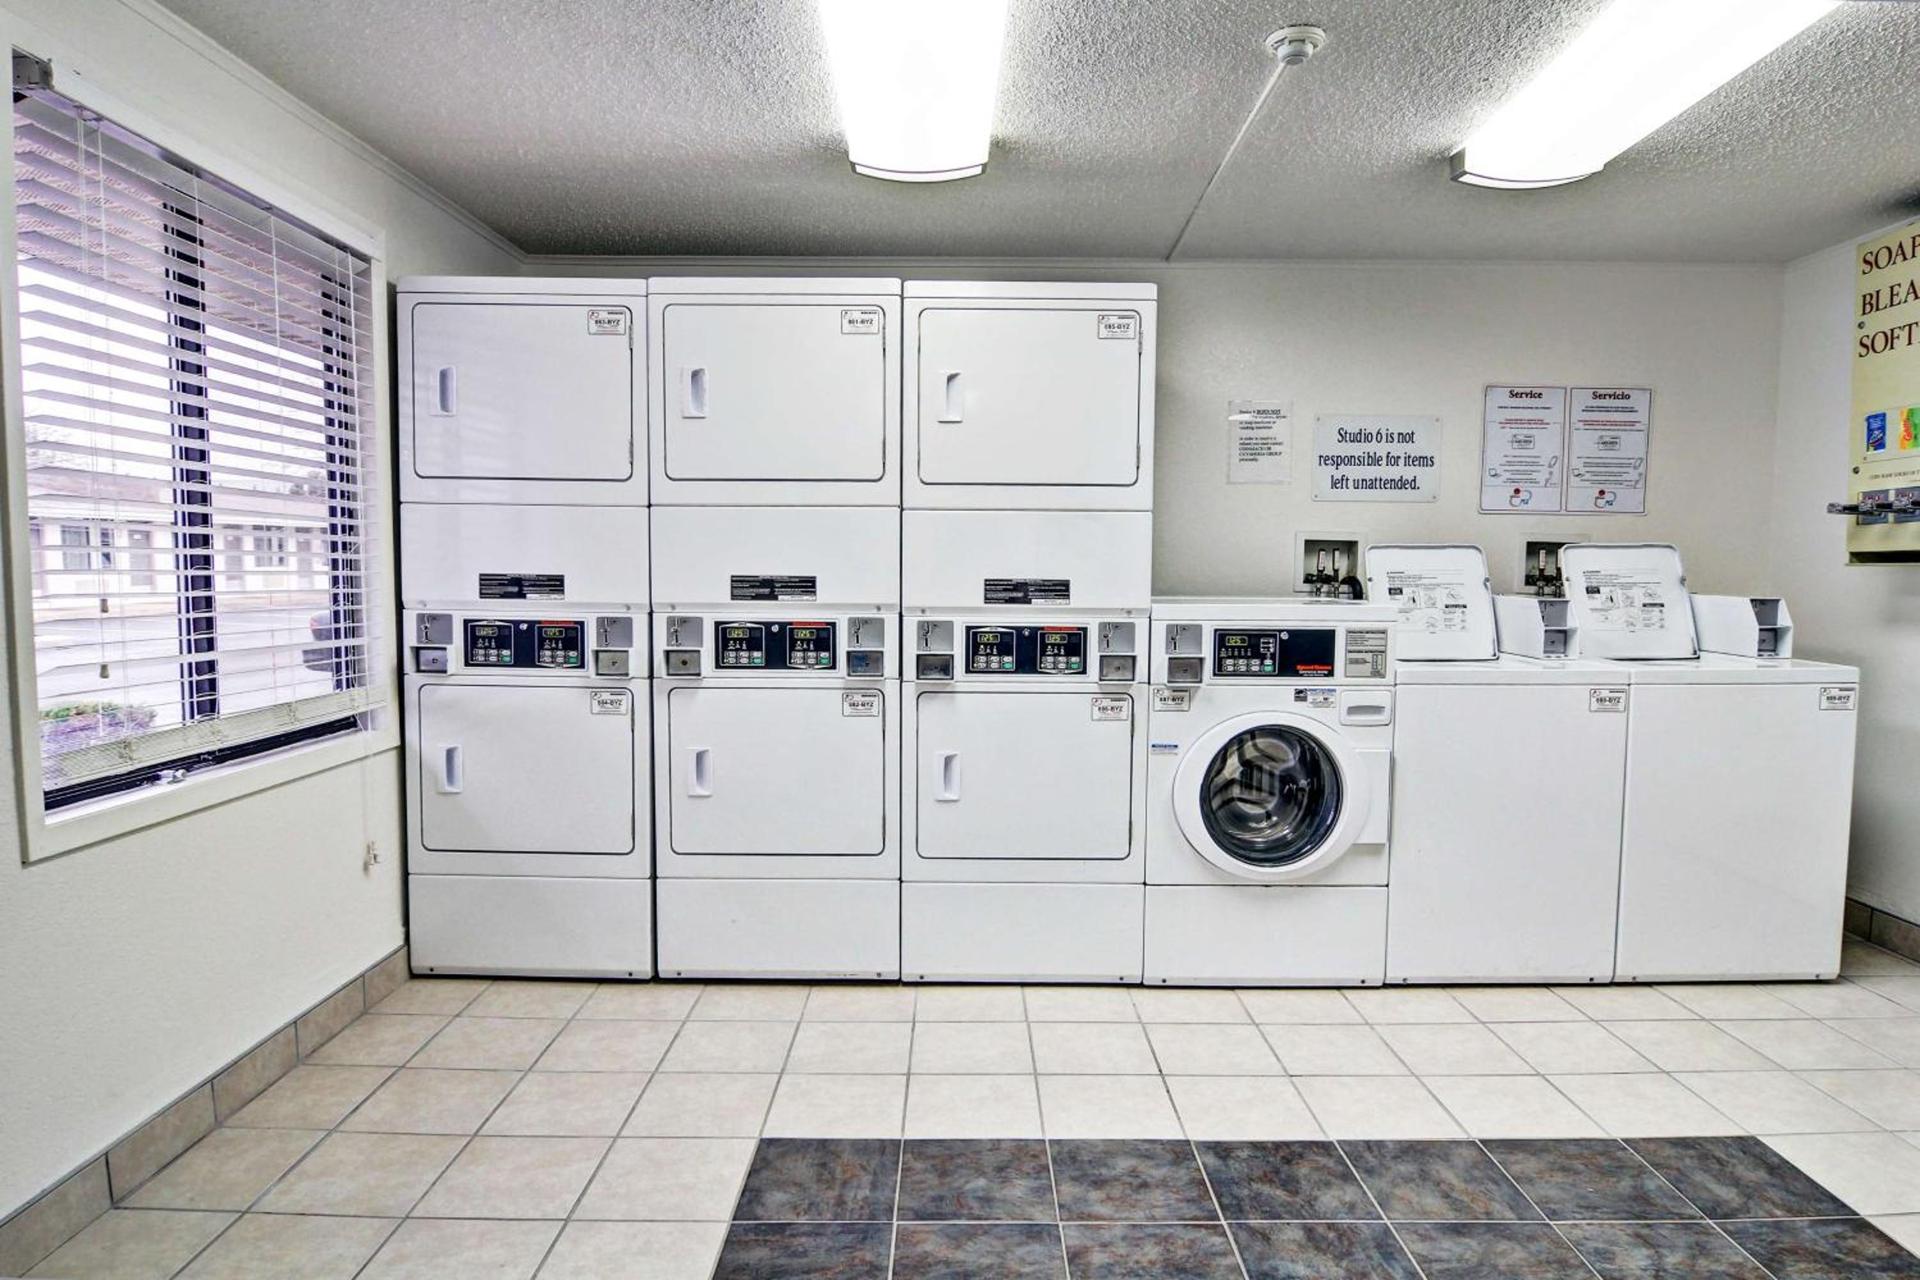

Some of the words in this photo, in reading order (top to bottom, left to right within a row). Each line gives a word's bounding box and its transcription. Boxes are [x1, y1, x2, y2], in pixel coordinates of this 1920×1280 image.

[1859, 322, 1920, 358] SOFT
[1508, 389, 1543, 399] Service
[1592, 391, 1631, 400] Servicio
[1337, 427, 1374, 444] Studio
[1375, 427, 1384, 444] 6
[1385, 428, 1395, 444] is
[1397, 430, 1416, 444] not
[1318, 451, 1383, 470] responsible
[1385, 451, 1401, 467] for
[1403, 452, 1435, 467] items
[1330, 474, 1350, 490] left
[1352, 475, 1421, 490] unattended.
